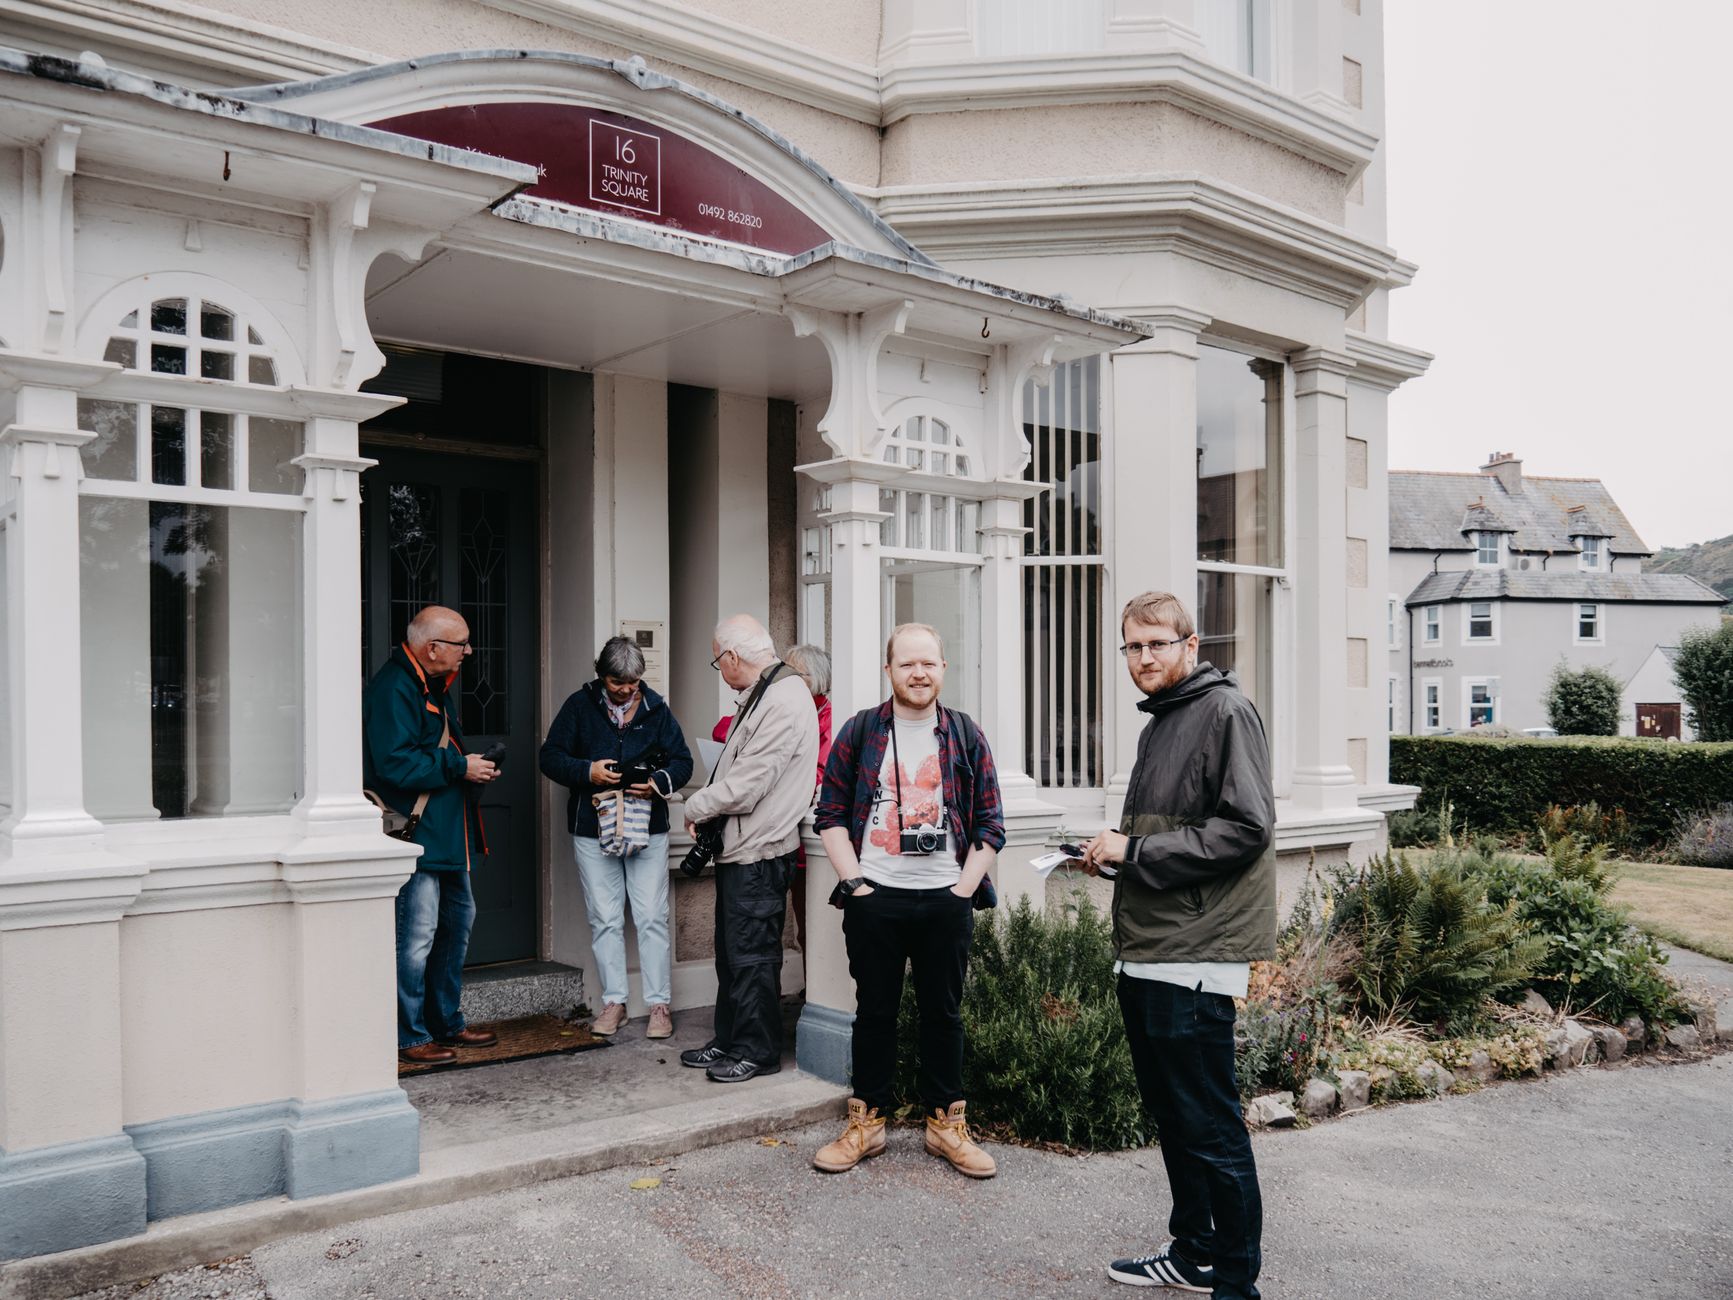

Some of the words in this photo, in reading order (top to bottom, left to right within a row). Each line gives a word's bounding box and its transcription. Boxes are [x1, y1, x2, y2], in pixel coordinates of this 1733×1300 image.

[616, 136, 636, 164] 16
[602, 164, 648, 187] TRINITY
[601, 179, 649, 202] SQUARE
[698, 203, 725, 220] 01492
[727, 210, 763, 229] 862820
[851, 1104, 861, 1114] CAT
[953, 1107, 964, 1116] CAT
